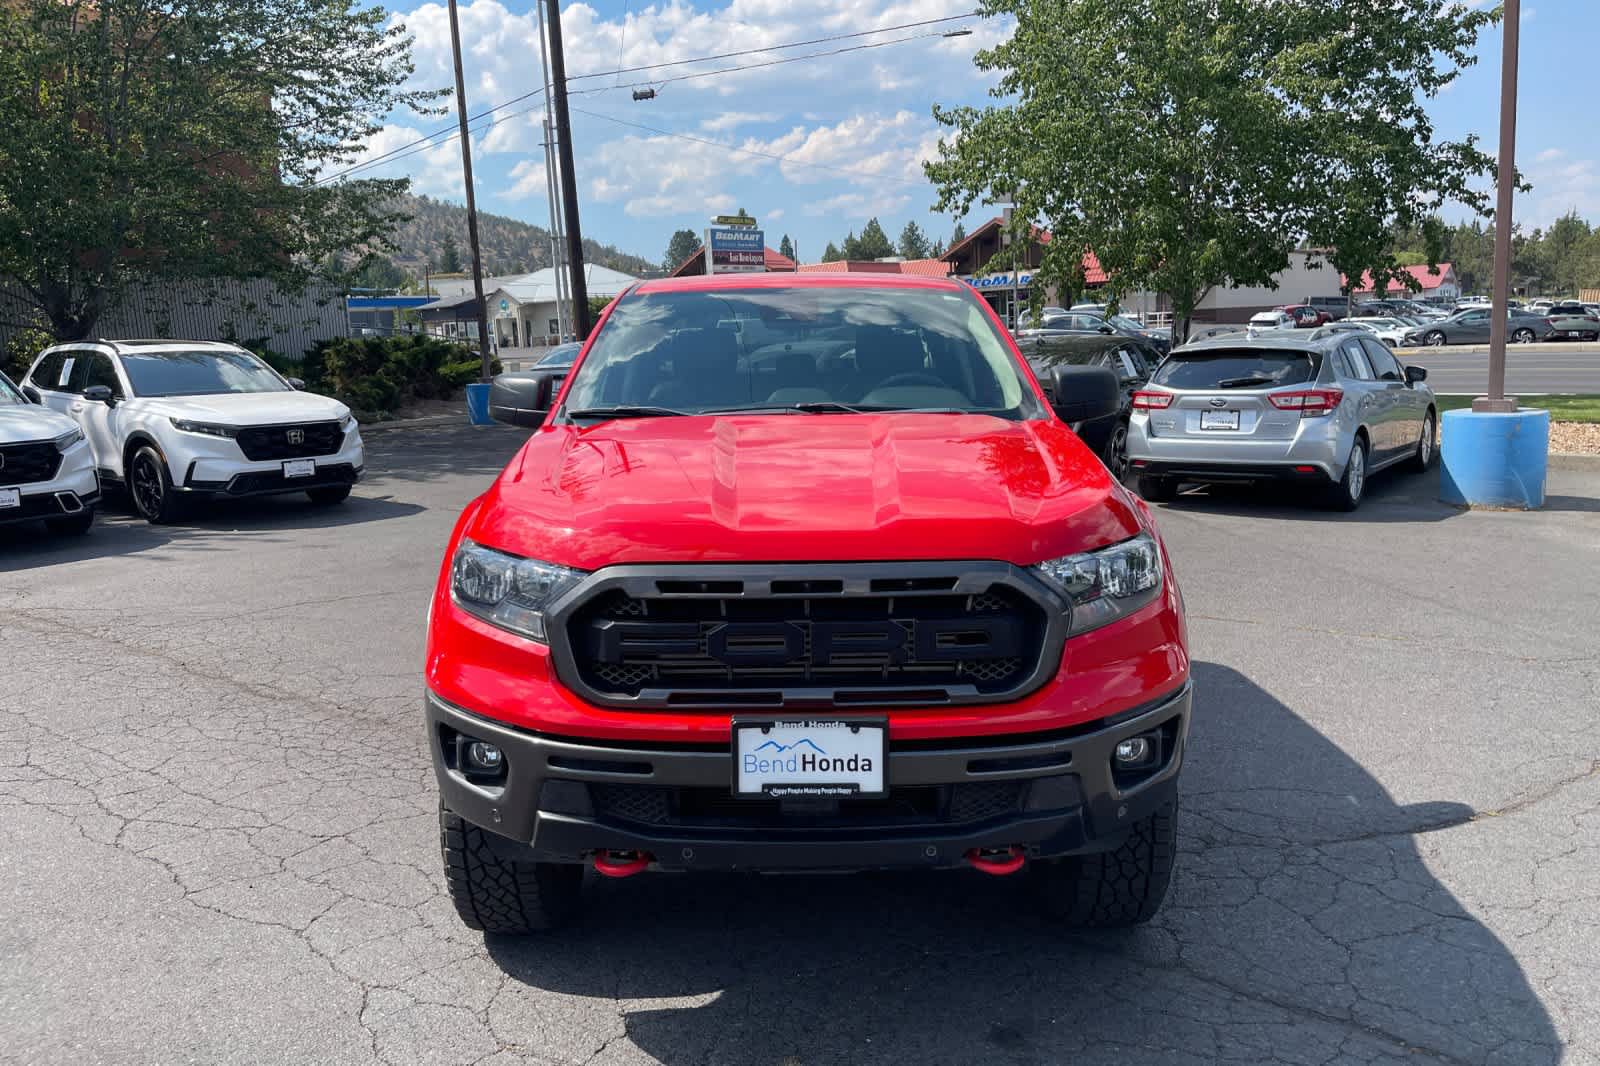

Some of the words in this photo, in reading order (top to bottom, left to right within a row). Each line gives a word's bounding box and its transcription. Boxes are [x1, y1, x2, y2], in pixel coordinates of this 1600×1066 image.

[715, 231, 760, 241] BEDMART
[593, 618, 1017, 664] FORD
[743, 754, 798, 773] Bend
[801, 753, 873, 772] Honda
[803, 787, 821, 795] Making
